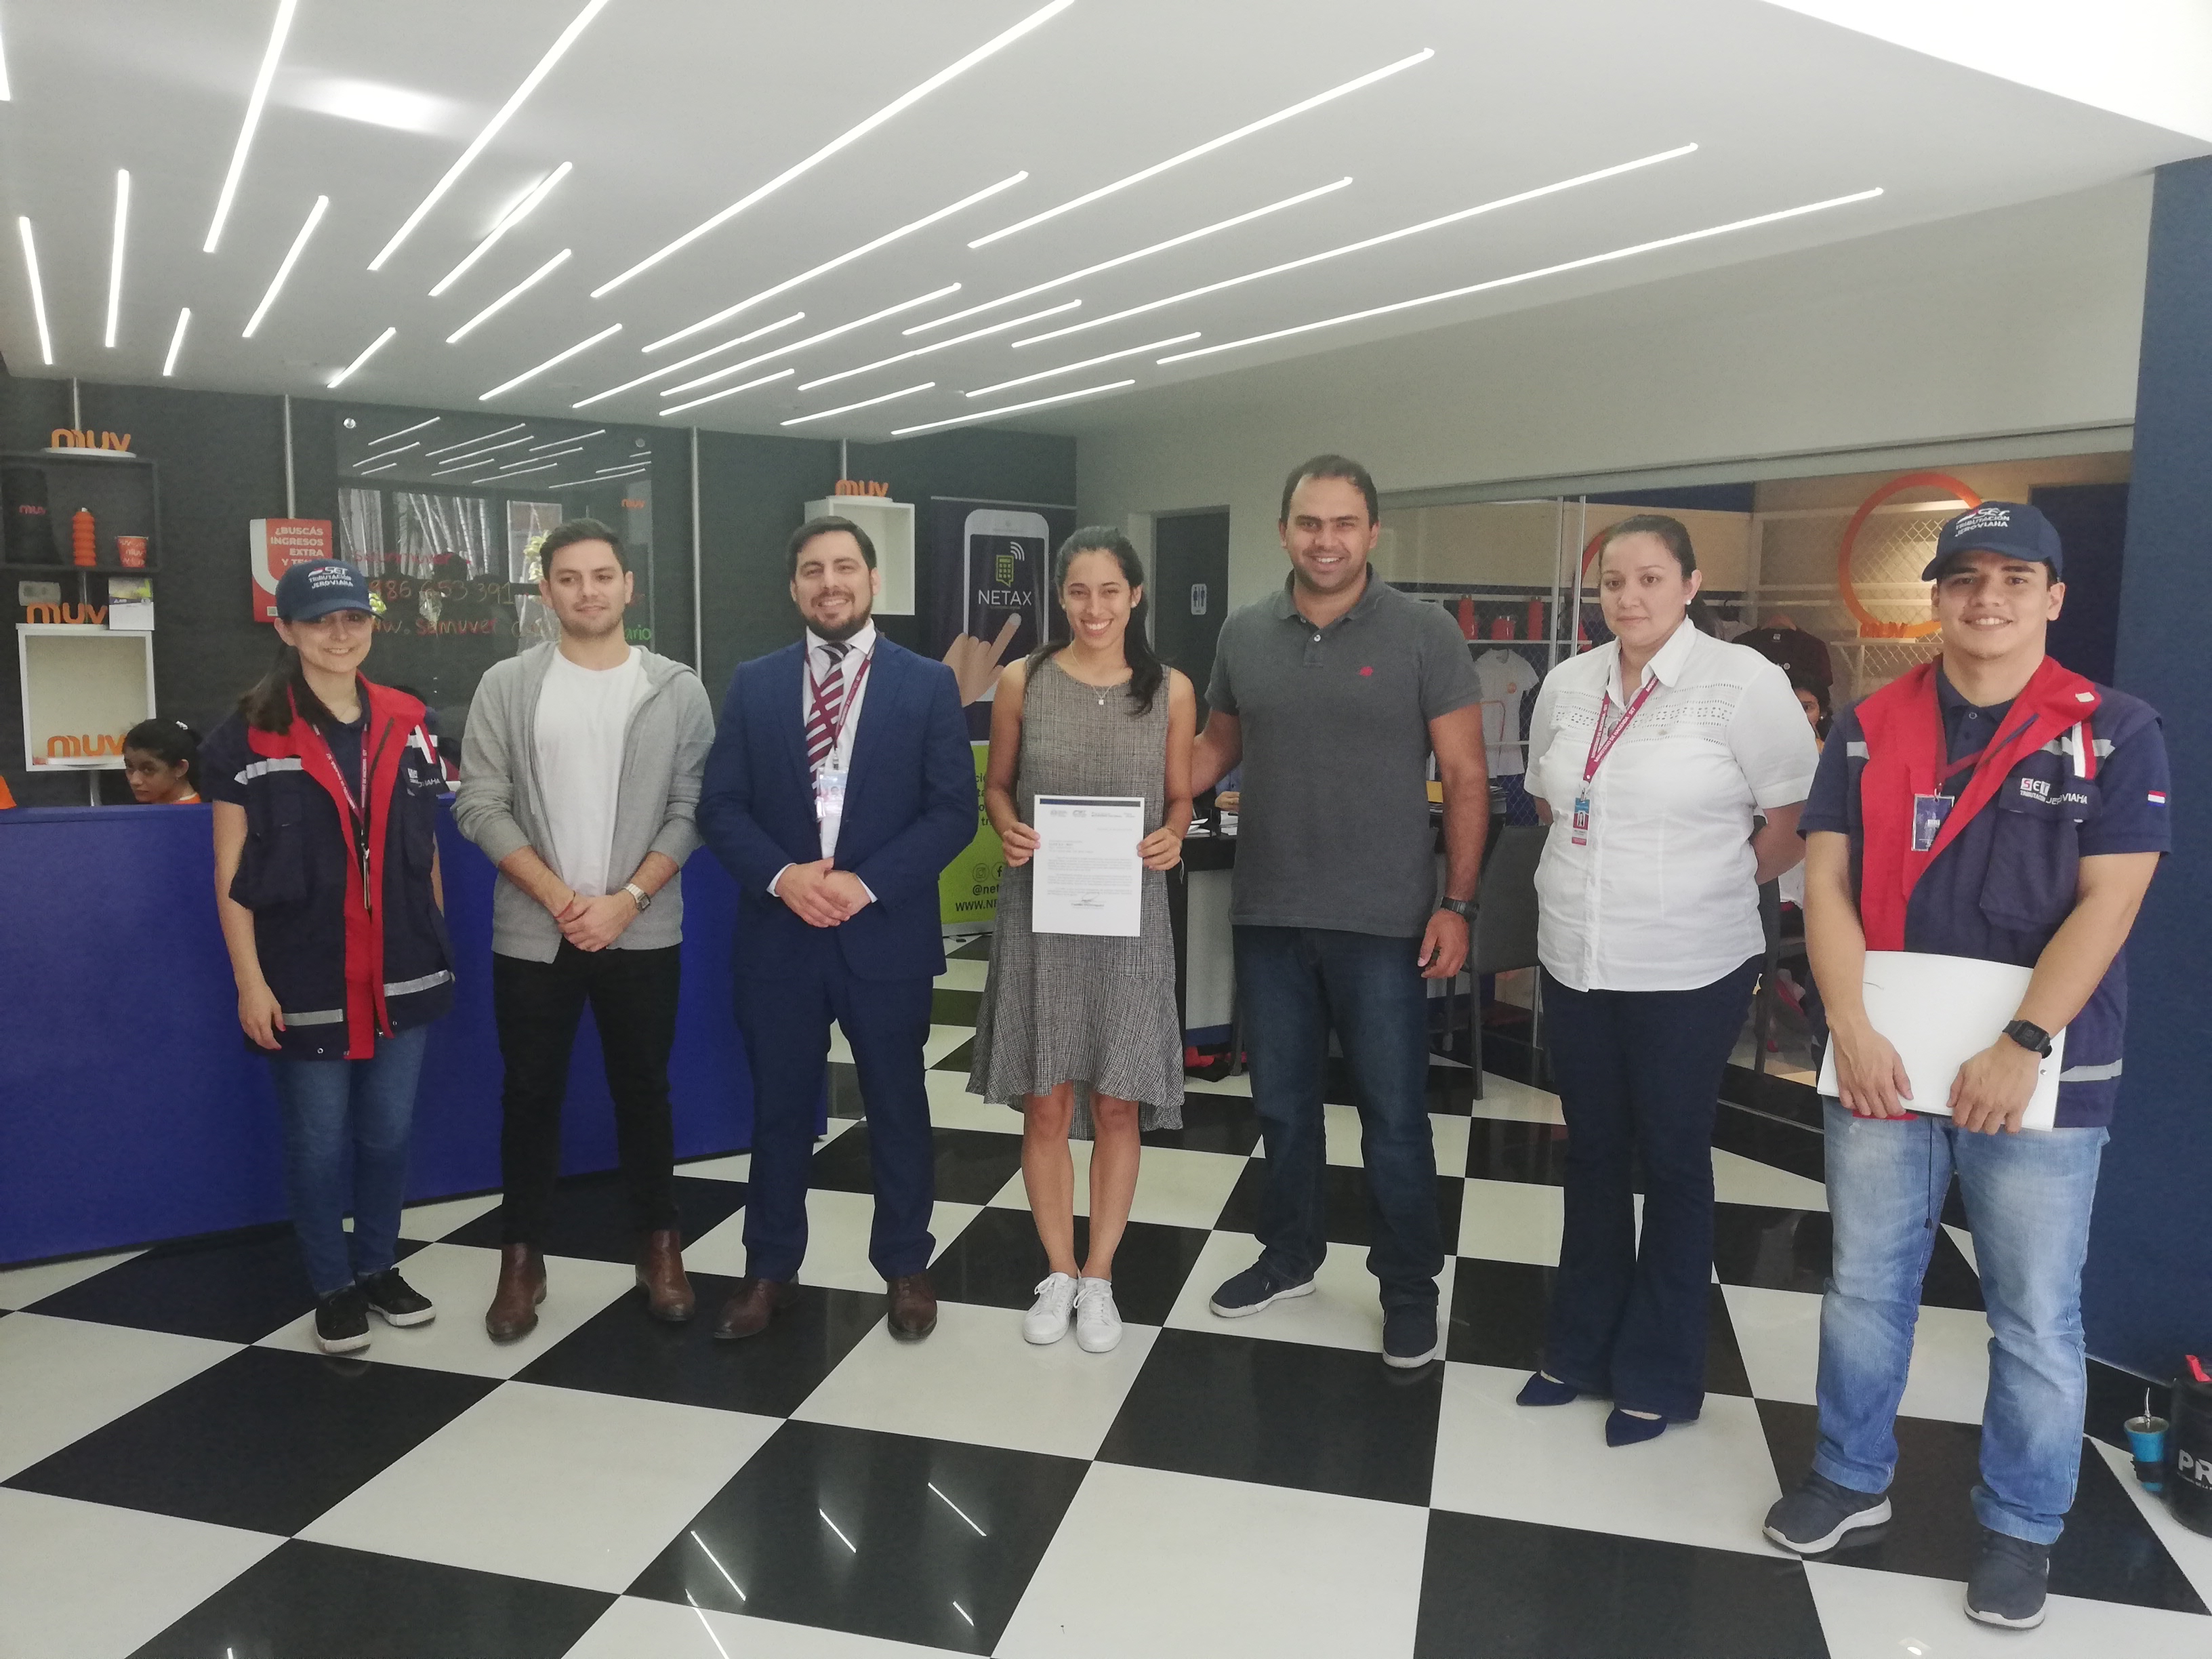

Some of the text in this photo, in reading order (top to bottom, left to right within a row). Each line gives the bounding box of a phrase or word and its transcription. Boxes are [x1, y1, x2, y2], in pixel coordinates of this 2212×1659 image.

[51, 428, 131, 452] muv
[835, 479, 889, 497] muv
[275, 526, 324, 535] ¿BUSCÁS
[270, 536, 324, 546] INGRESOS
[289, 548, 324, 556] EXTRA
[978, 590, 1031, 606] NETAX
[26, 602, 108, 624] muv
[2020, 777, 2051, 797] SET
